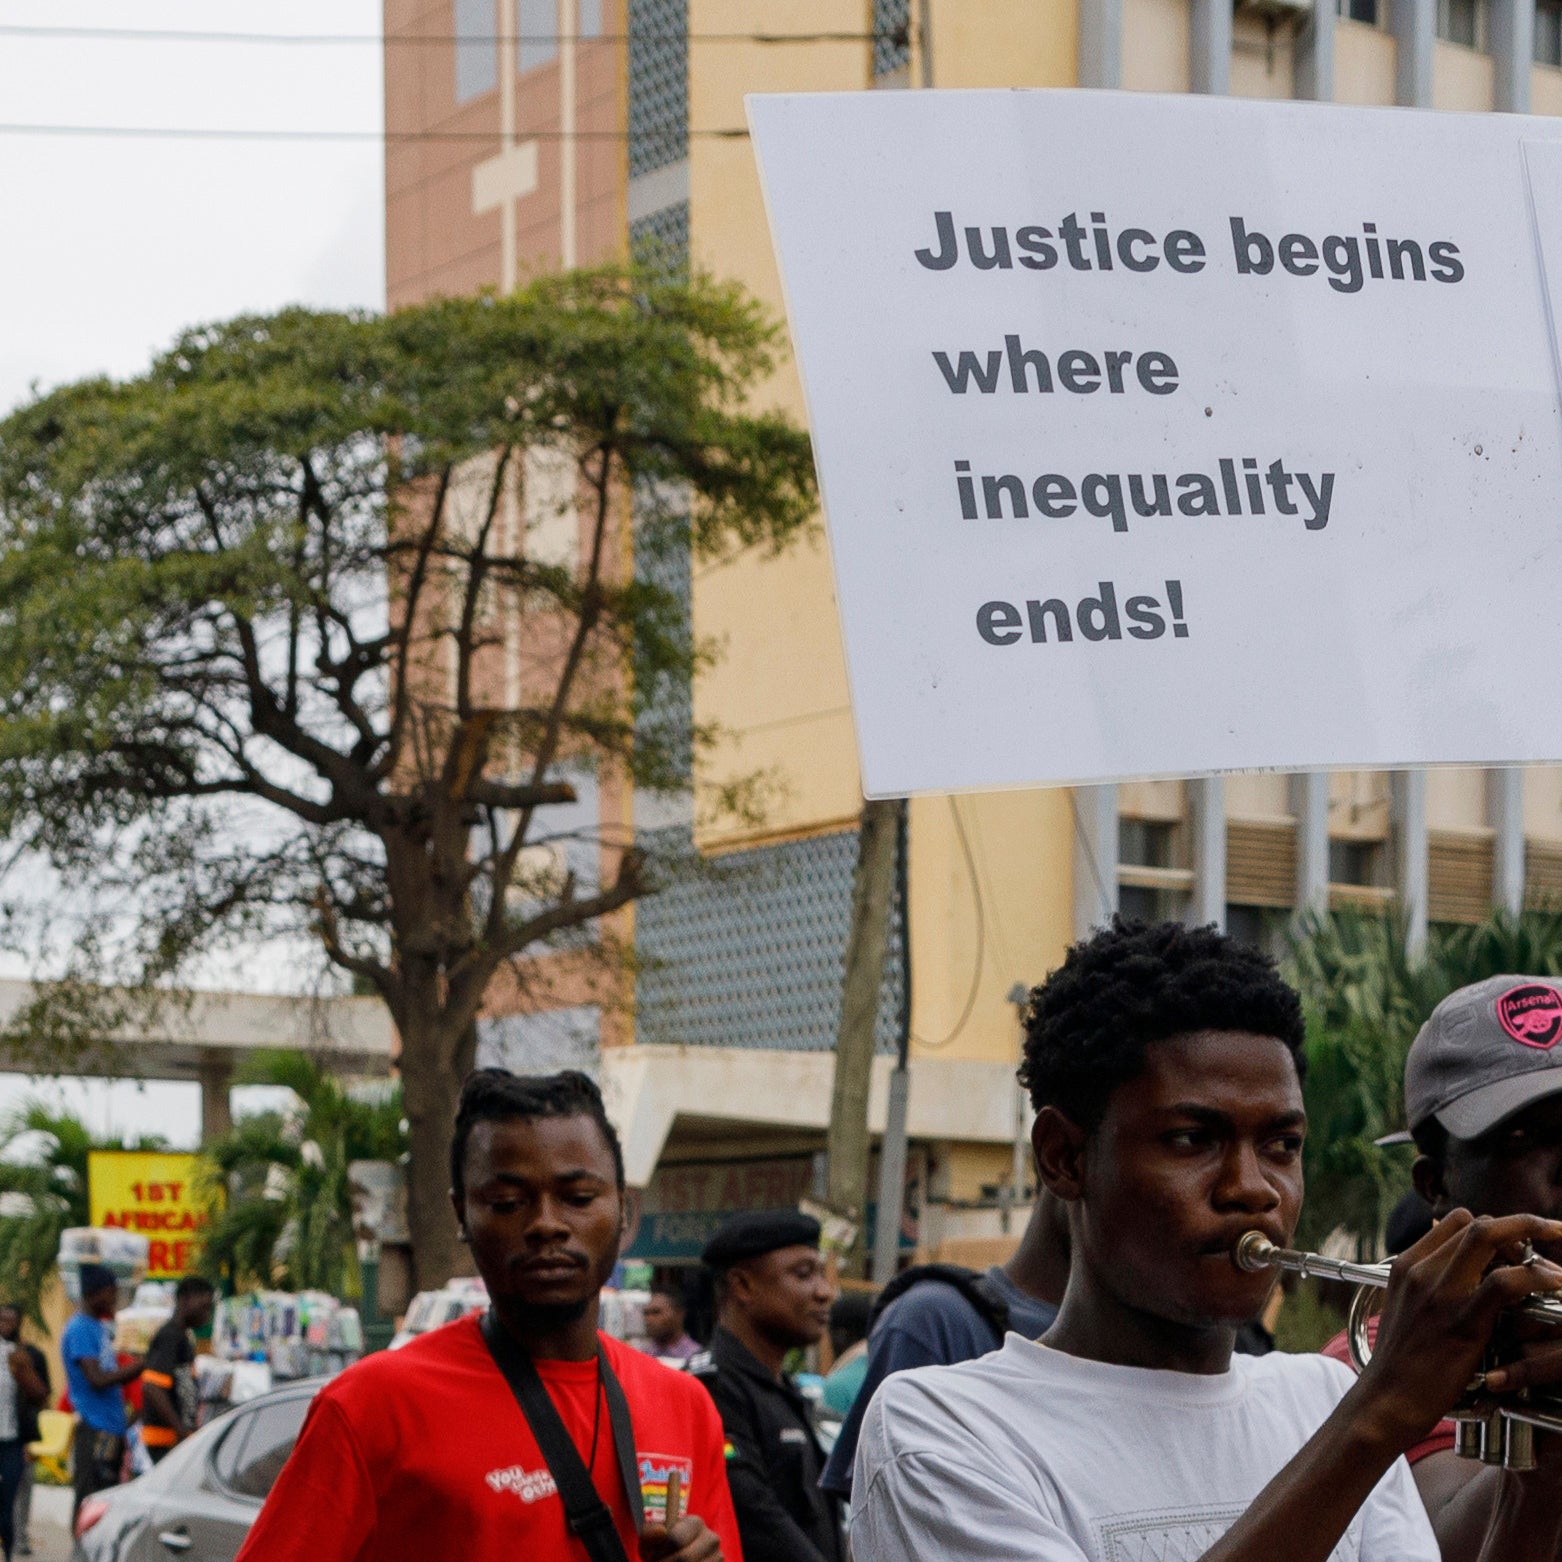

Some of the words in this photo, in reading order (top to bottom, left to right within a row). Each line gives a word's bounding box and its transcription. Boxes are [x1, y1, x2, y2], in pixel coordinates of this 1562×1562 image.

[913, 211, 1207, 274] Justice
[1229, 216, 1465, 294] begins
[931, 334, 1180, 396] where
[953, 457, 1336, 533] inequality
[975, 579, 1190, 646] ends!
[1508, 990, 1556, 1011] Arsenal
